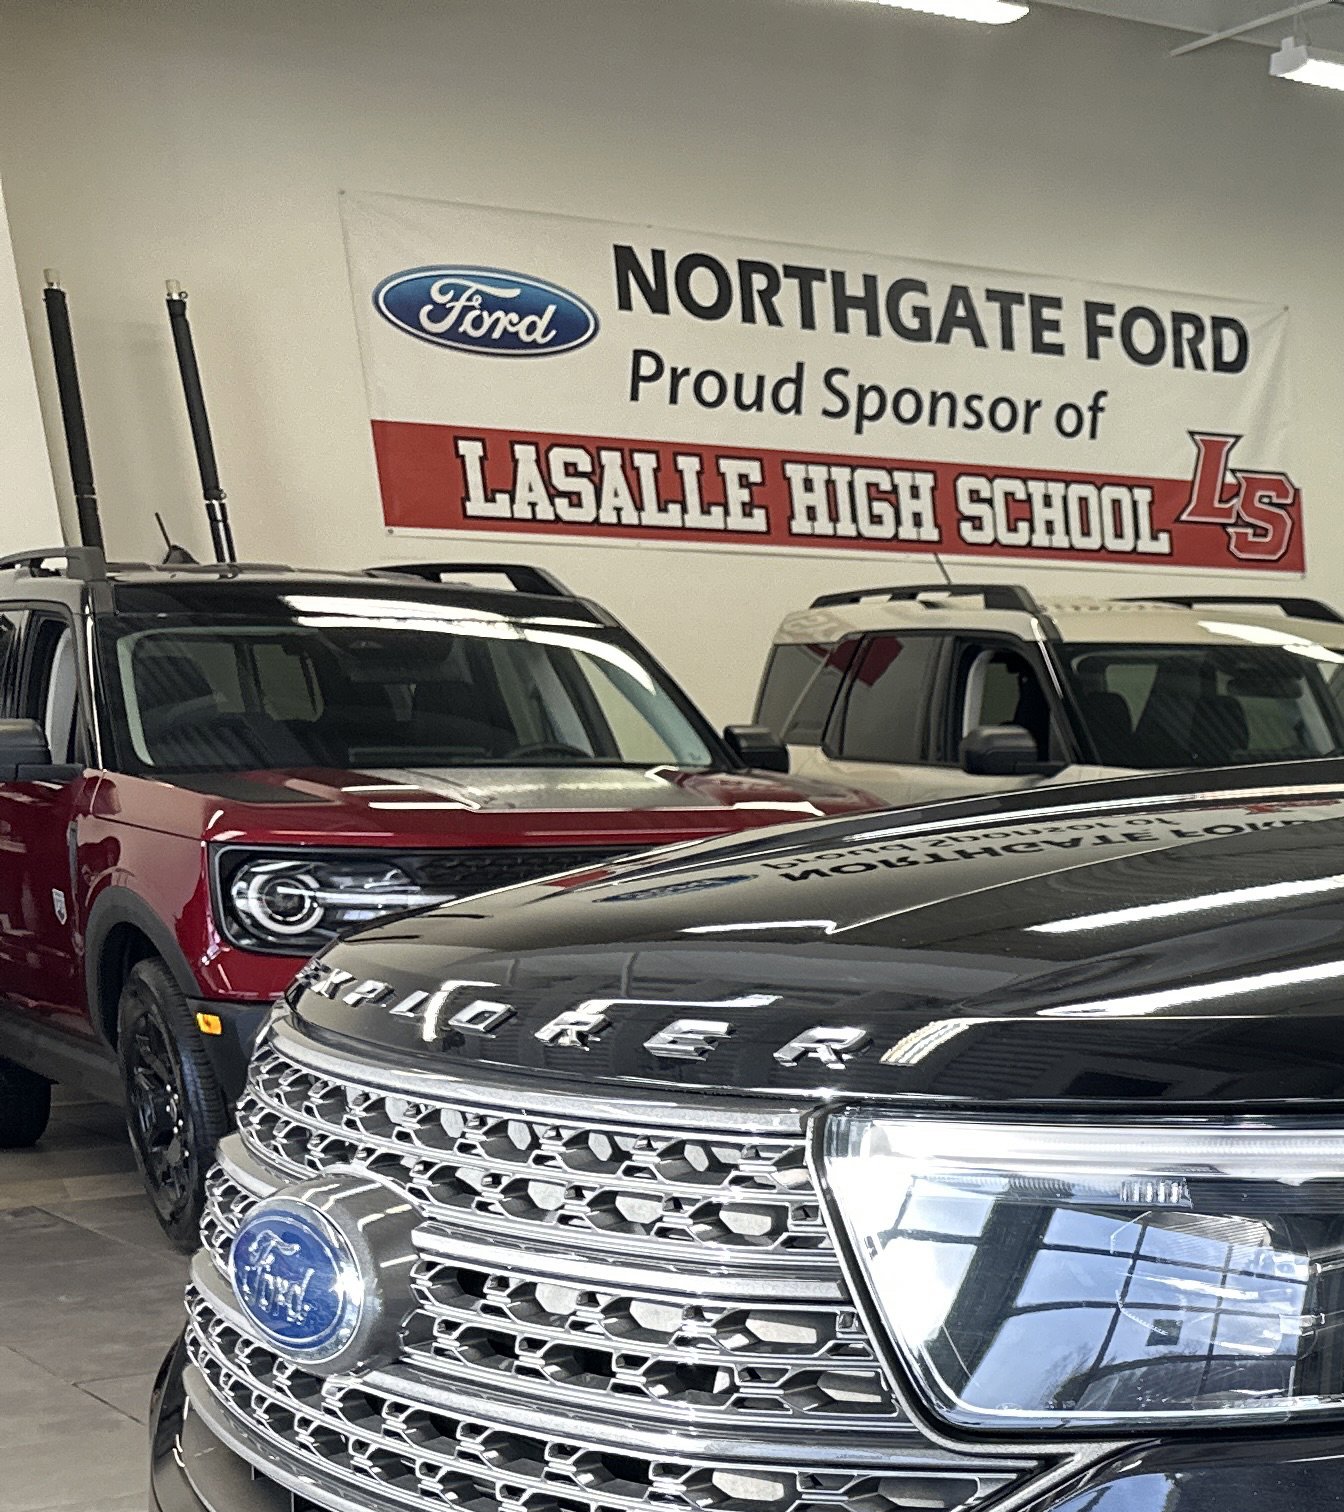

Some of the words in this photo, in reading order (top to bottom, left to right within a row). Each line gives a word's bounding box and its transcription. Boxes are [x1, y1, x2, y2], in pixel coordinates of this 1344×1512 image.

[419, 278, 557, 344] Ford
[613, 243, 1065, 357] NORTHGATE
[1084, 300, 1249, 374] FORD
[629, 349, 806, 416] Proud
[821, 366, 1042, 435] Sponsor
[1054, 390, 1108, 440] of
[454, 436, 770, 534] LASALLE
[783, 461, 943, 544] HIGH
[954, 474, 1172, 555] SCHOOL
[1175, 431, 1297, 561] LS
[240, 1229, 317, 1326] Ford
